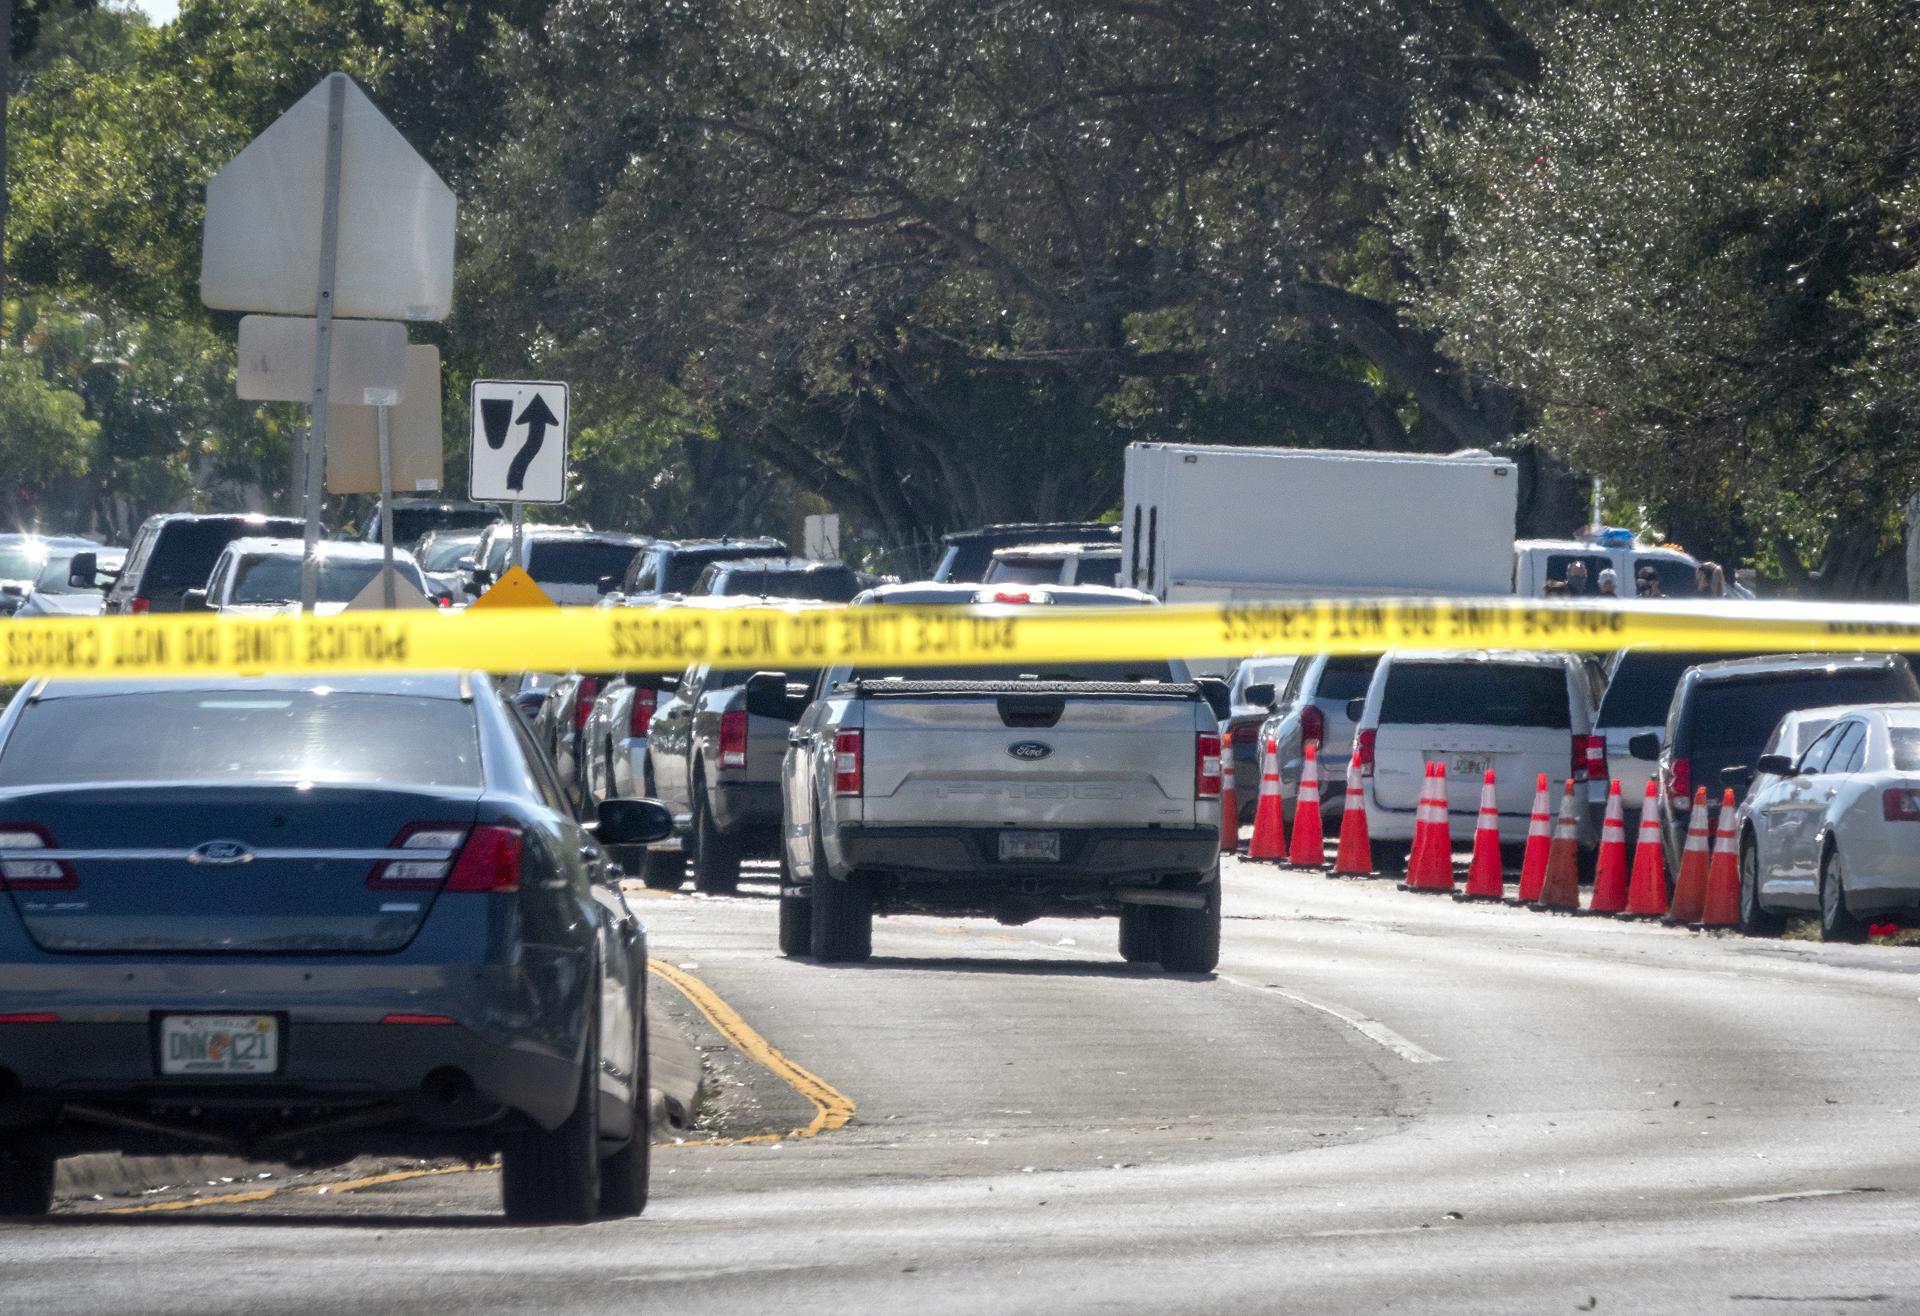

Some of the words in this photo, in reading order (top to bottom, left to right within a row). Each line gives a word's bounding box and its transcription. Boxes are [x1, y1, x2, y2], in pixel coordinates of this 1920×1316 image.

[6, 629, 99, 668] CROSS
[114, 628, 167, 667] NOT
[184, 627, 220, 666] DO
[234, 624, 292, 664] LINE
[307, 623, 408, 663] POLICE
[609, 618, 705, 660] CROSS
[719, 617, 776, 658] NOT
[790, 616, 827, 657] DO
[840, 614, 904, 655] LINE
[206, 843, 239, 858] Ford
